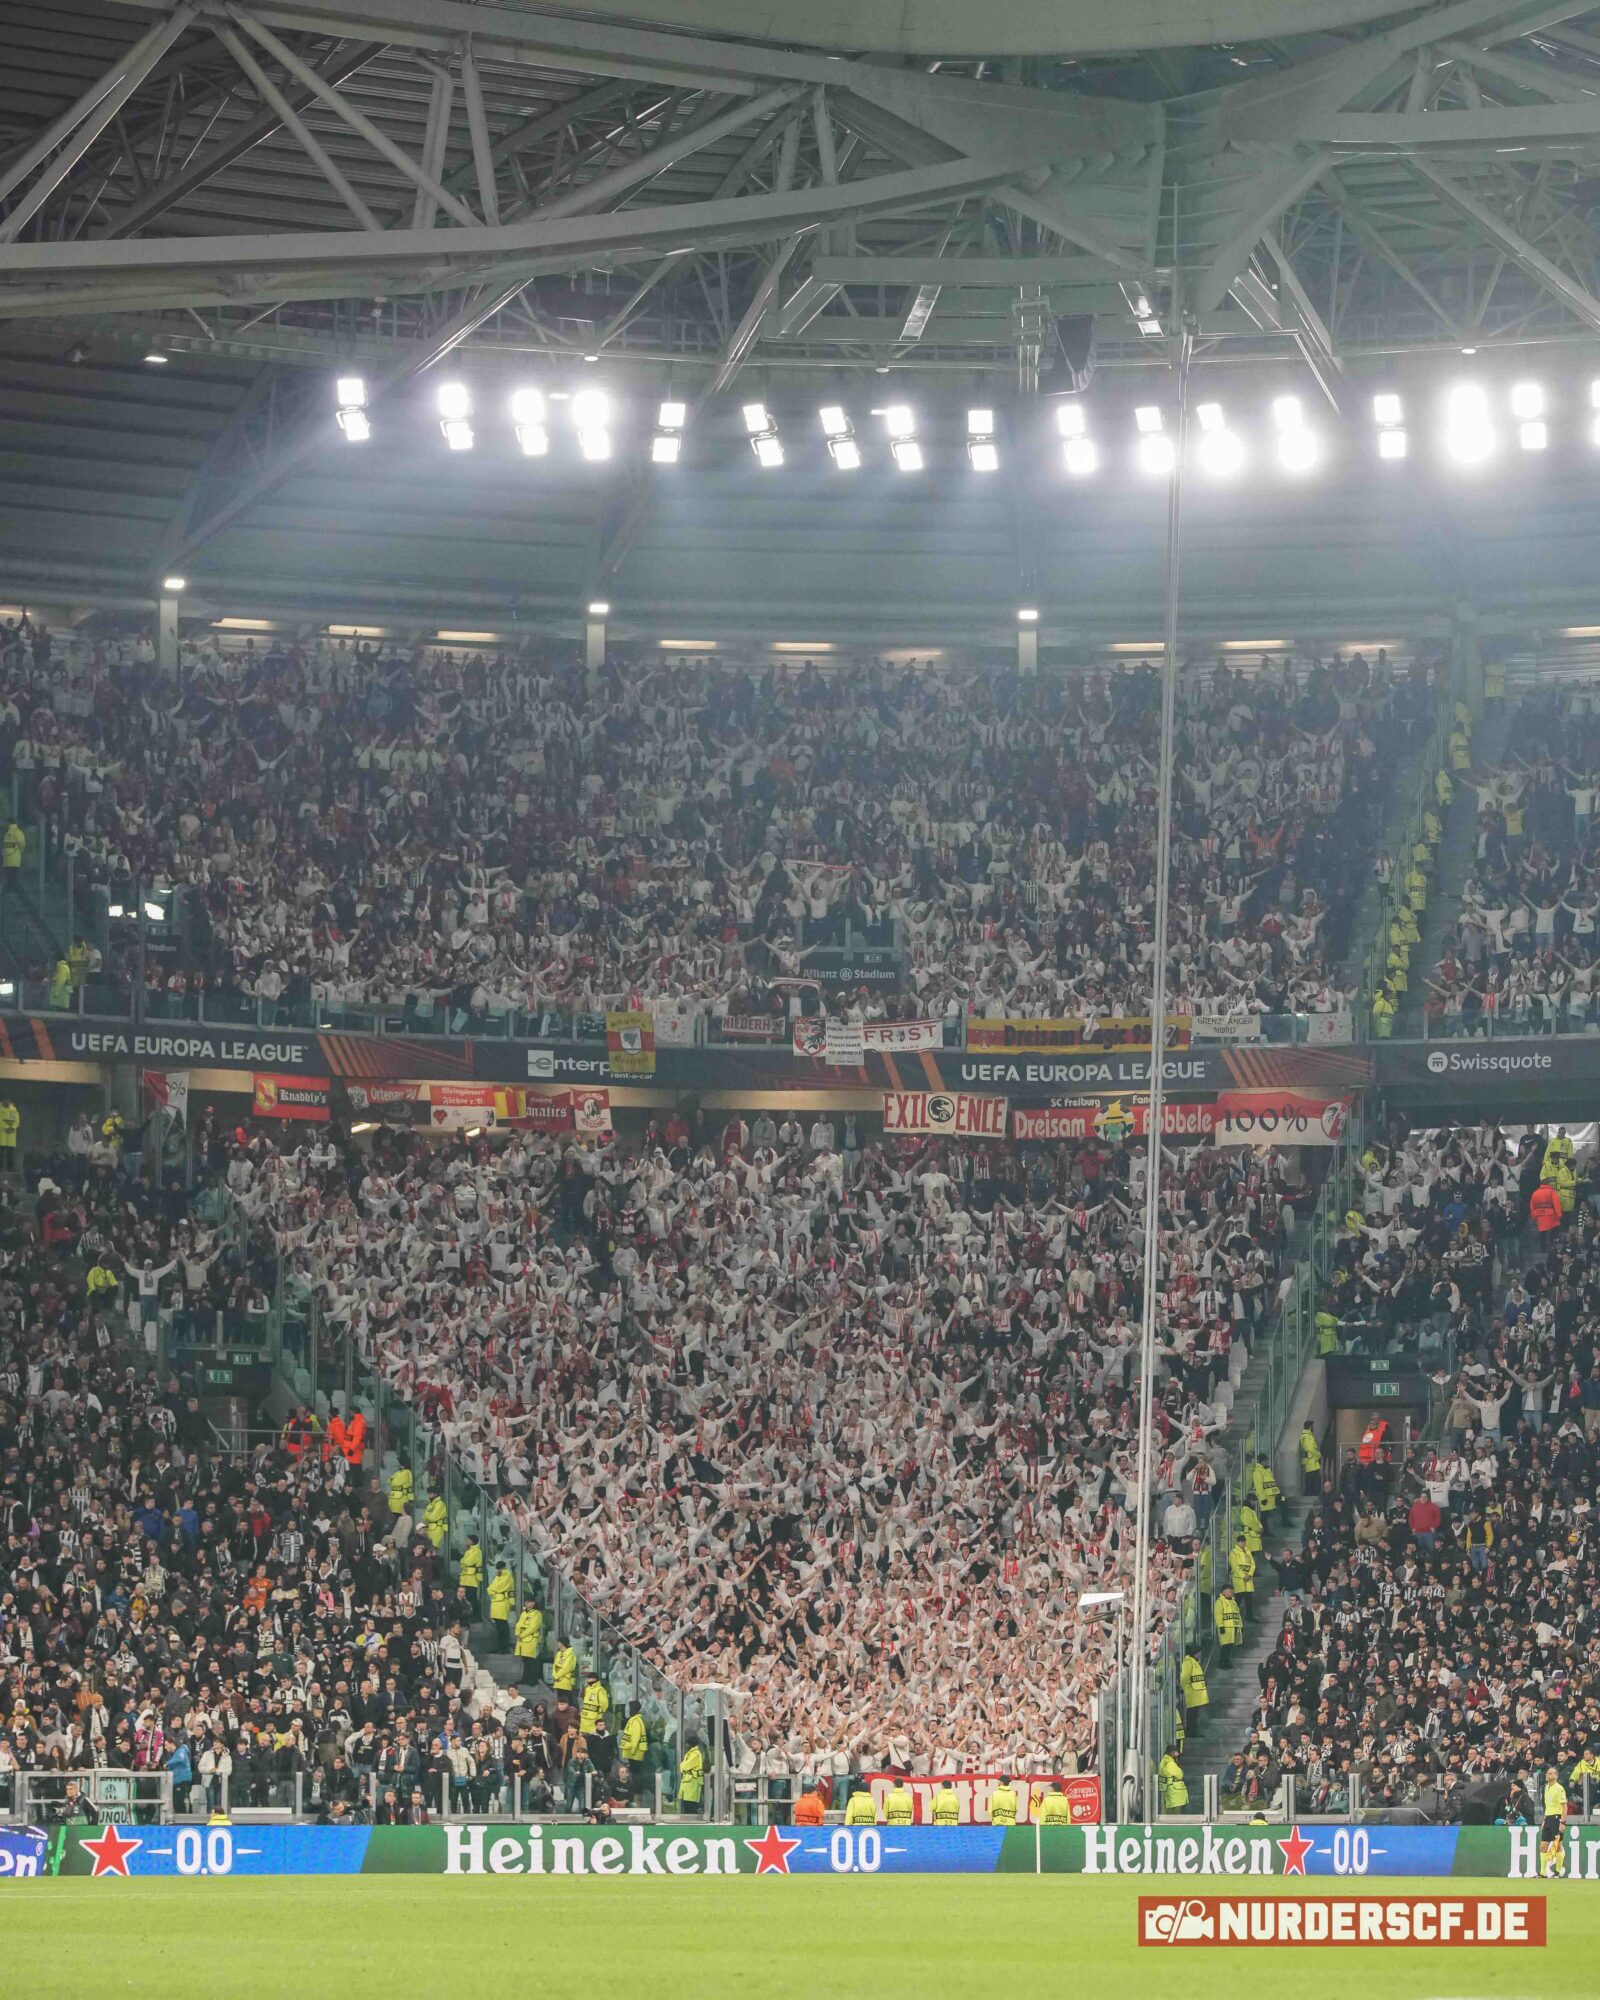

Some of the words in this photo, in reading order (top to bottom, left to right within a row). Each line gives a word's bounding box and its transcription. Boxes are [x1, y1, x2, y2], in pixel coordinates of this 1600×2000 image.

[803, 969, 838, 979] Allianz
[854, 968, 895, 979] Stadium
[723, 1016, 784, 1032] NIEDERHF
[71, 1033, 129, 1053] UEFA
[134, 1037, 216, 1059] EUROPA
[221, 1042, 304, 1063] LEAGUE
[1450, 1052, 1552, 1074] Swissquote
[530, 1056, 611, 1076] enterp
[962, 1064, 1021, 1082] UEFA
[1026, 1063, 1114, 1082] EUROPA
[883, 1093, 930, 1128] EXIL
[1051, 1098, 1063, 1107] SC
[1064, 1096, 1101, 1108] Freiburg
[1015, 1110, 1086, 1137] Dreisam
[1224, 1103, 1308, 1133] 100%
[176, 1827, 233, 1875] 0.0
[443, 1825, 741, 1874] Heineken
[830, 1827, 882, 1873] 0.0
[1081, 1825, 1274, 1874] Heineken
[1332, 1827, 1369, 1874] 0.0
